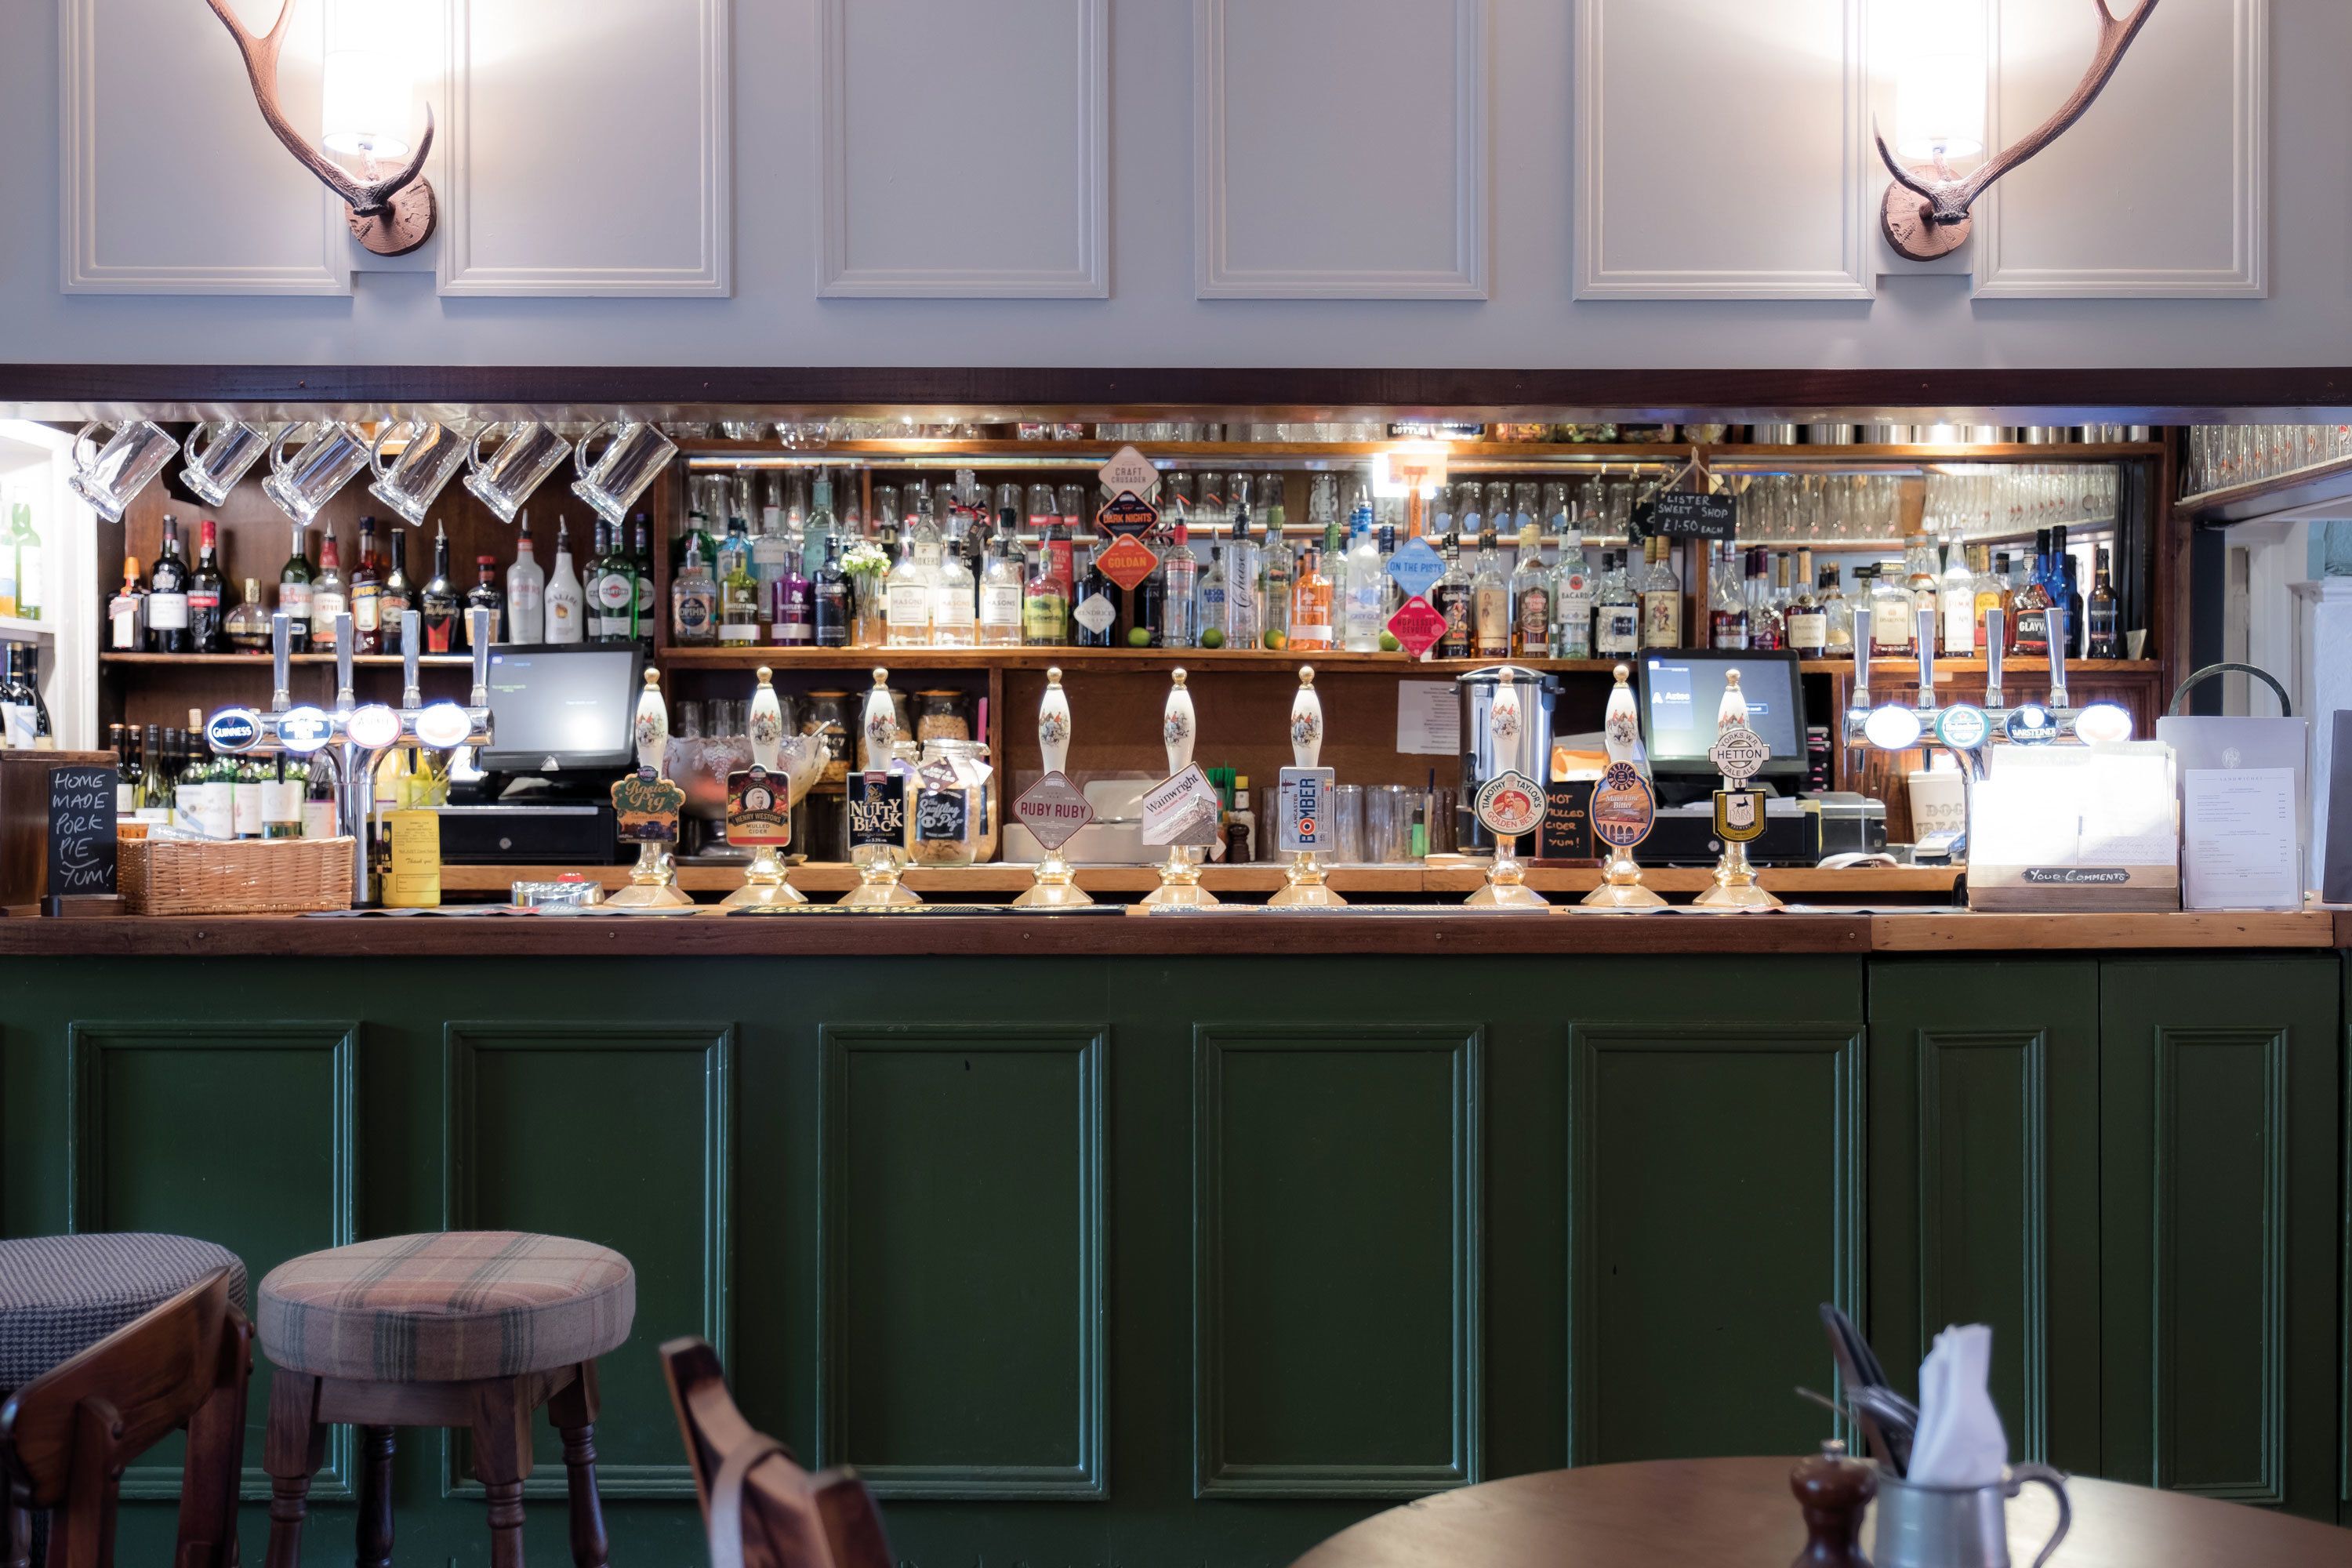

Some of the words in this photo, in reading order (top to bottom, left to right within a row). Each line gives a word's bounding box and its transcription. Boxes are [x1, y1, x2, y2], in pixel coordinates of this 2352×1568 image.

[1115, 467, 1142, 476] CRAFT
[1667, 495, 1711, 506] LISTER
[1658, 503, 1693, 514] SWEET
[1701, 507, 1728, 518] SHOP
[1103, 514, 1123, 524] DARK
[1125, 513, 1152, 524] NIGHTS
[1700, 525, 1723, 534] EACH
[1108, 557, 1147, 568] GOLDAN
[1390, 561, 1401, 572] ON
[1404, 562, 1418, 572] THE
[1421, 563, 1443, 573] PISTE
[1397, 618, 1436, 626] HOPLESSLY
[212, 726, 252, 739] GUINNESS
[2012, 728, 2056, 738] WARSTEINER
[1717, 750, 1762, 760] HETTON
[1611, 763, 1633, 775] SETTLE
[1723, 764, 1740, 776] PALE
[1743, 764, 1755, 776] ALE
[55, 773, 106, 789] HOME
[1146, 774, 1199, 813] Wainwright
[1483, 781, 1505, 810] TIMOTHY
[1516, 780, 1541, 808] TAYLOR'S
[1547, 794, 1573, 804] HOT
[53, 792, 109, 809] MADE
[630, 792, 666, 812] Pig
[850, 798, 901, 820] NUTTY
[1021, 801, 1052, 816] RUBY
[1055, 804, 1087, 818] RUBY
[1299, 779, 1316, 843] BOMBER
[1926, 804, 1963, 817] DOG
[56, 812, 103, 835] PORK
[735, 813, 753, 824] HENRY
[754, 812, 781, 824] WESTONS
[852, 813, 902, 832] BLACK
[1487, 811, 1518, 828] GOLDEN
[1520, 811, 1537, 826] BEST
[1545, 822, 1577, 830] CIDER
[60, 837, 93, 860] PIE
[60, 864, 114, 887] YUM!
[2066, 870, 2126, 882] COMMENTS
